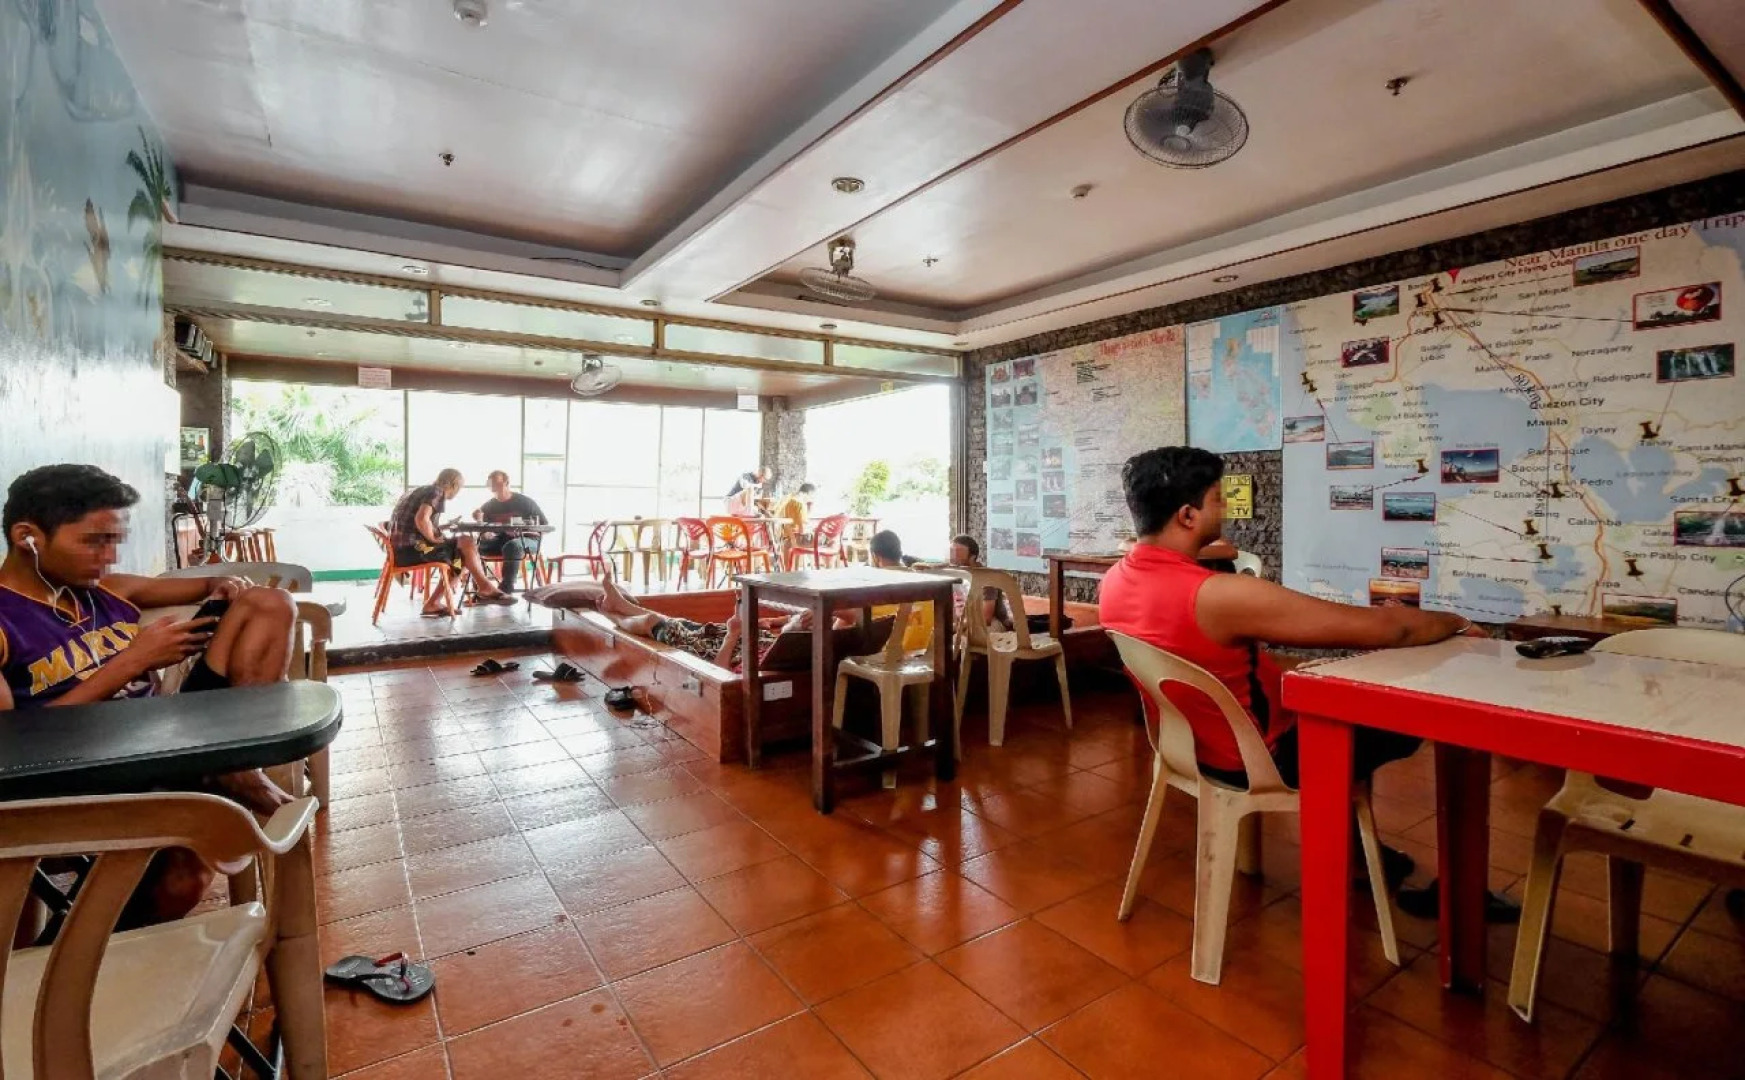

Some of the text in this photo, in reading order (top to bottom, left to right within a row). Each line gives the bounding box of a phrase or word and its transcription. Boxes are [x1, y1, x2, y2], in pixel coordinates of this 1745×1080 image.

[1504, 255, 1540, 269] Near
[1549, 240, 1610, 259] Manila
[1614, 234, 1649, 248] one
[1655, 224, 1692, 240] day
[1571, 344, 1634, 357] Norzagaray
[1593, 372, 1653, 383] Rodriguez
[1529, 397, 1605, 410] Quezon City
[1526, 418, 1568, 427] Manila
[1580, 426, 1617, 435] Taytay
[1579, 478, 1614, 486] Pedro
[1669, 495, 1708, 504] Santa
[1567, 517, 1622, 527] Calamba
[1623, 550, 1716, 564] San Pablo City
